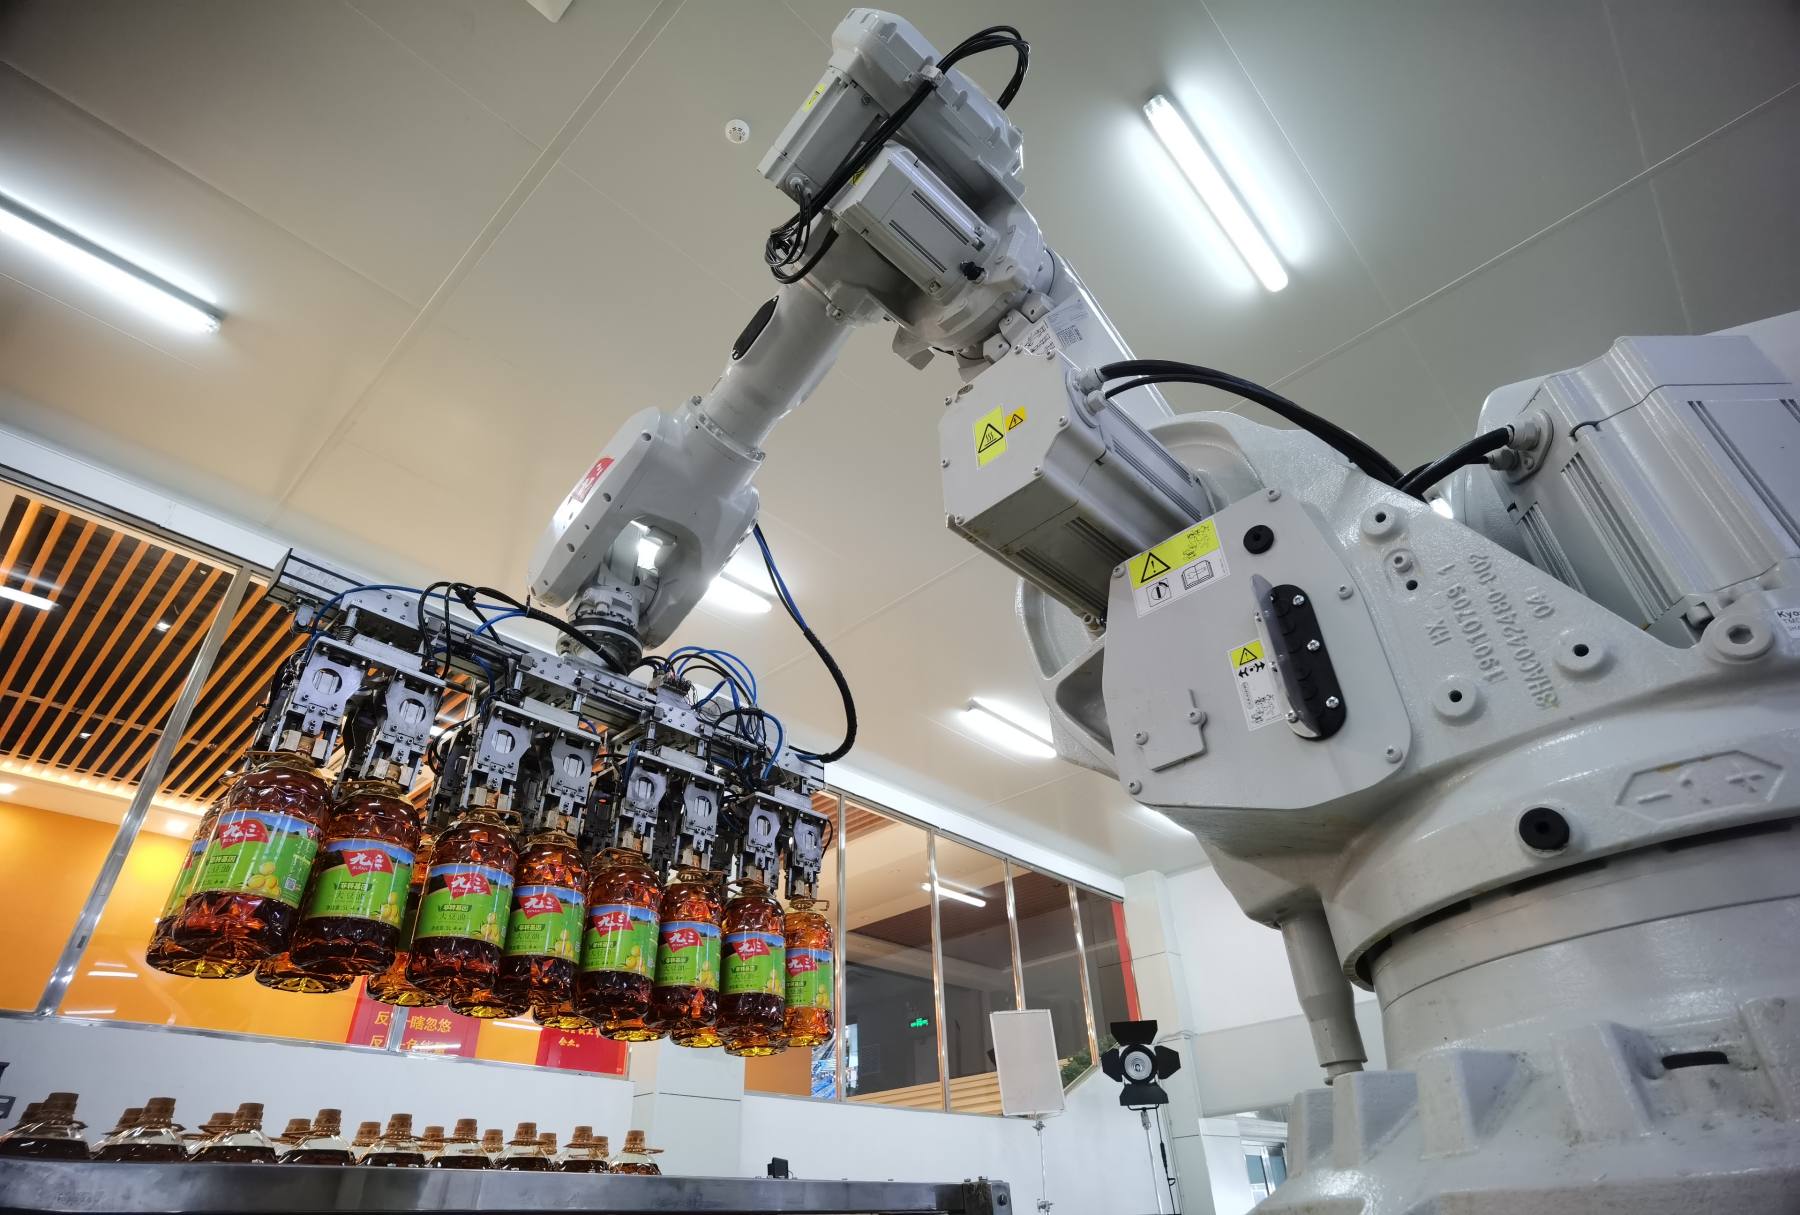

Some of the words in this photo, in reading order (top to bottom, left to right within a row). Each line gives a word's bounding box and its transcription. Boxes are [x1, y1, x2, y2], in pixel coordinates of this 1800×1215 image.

[223, 824, 257, 838] 九三
[350, 853, 384, 870] 九三
[451, 876, 482, 892] 九三
[524, 897, 554, 910] 九三
[598, 914, 625, 927] 九三
[669, 931, 695, 944] 九三
[738, 941, 763, 953] 九三
[788, 957, 811, 968] 九三
